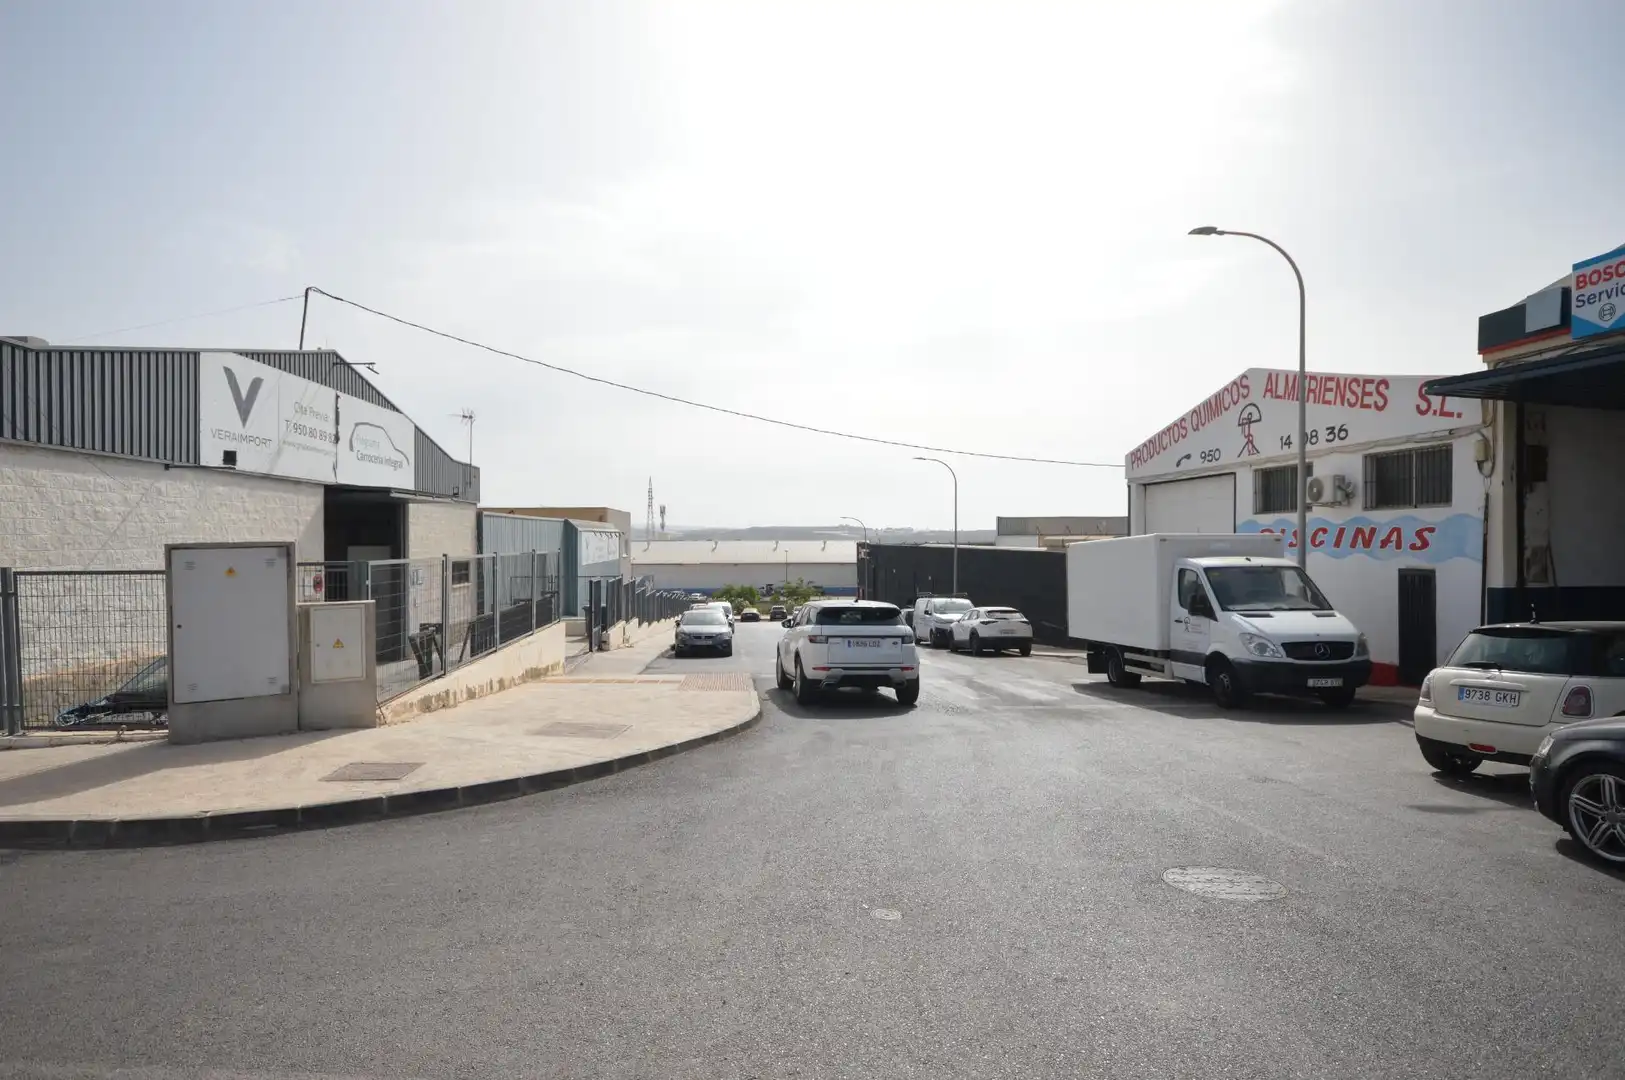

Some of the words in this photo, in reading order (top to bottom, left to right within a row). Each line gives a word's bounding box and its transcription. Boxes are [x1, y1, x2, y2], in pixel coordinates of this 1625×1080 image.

[293, 422, 308, 437] 950
[1130, 417, 1188, 470] PRODUCTOS
[1190, 373, 1251, 432] QUIMICOS
[1263, 371, 1390, 412] ALMRIENSES
[210, 427, 272, 448] VERAIMPORT
[1200, 448, 1221, 464] 950
[1279, 434, 1293, 450] 14
[1325, 423, 1349, 443] 36
[1259, 526, 1436, 551] SCINAS
[1465, 689, 1490, 701] 9738
[1495, 691, 1517, 705] GKH
